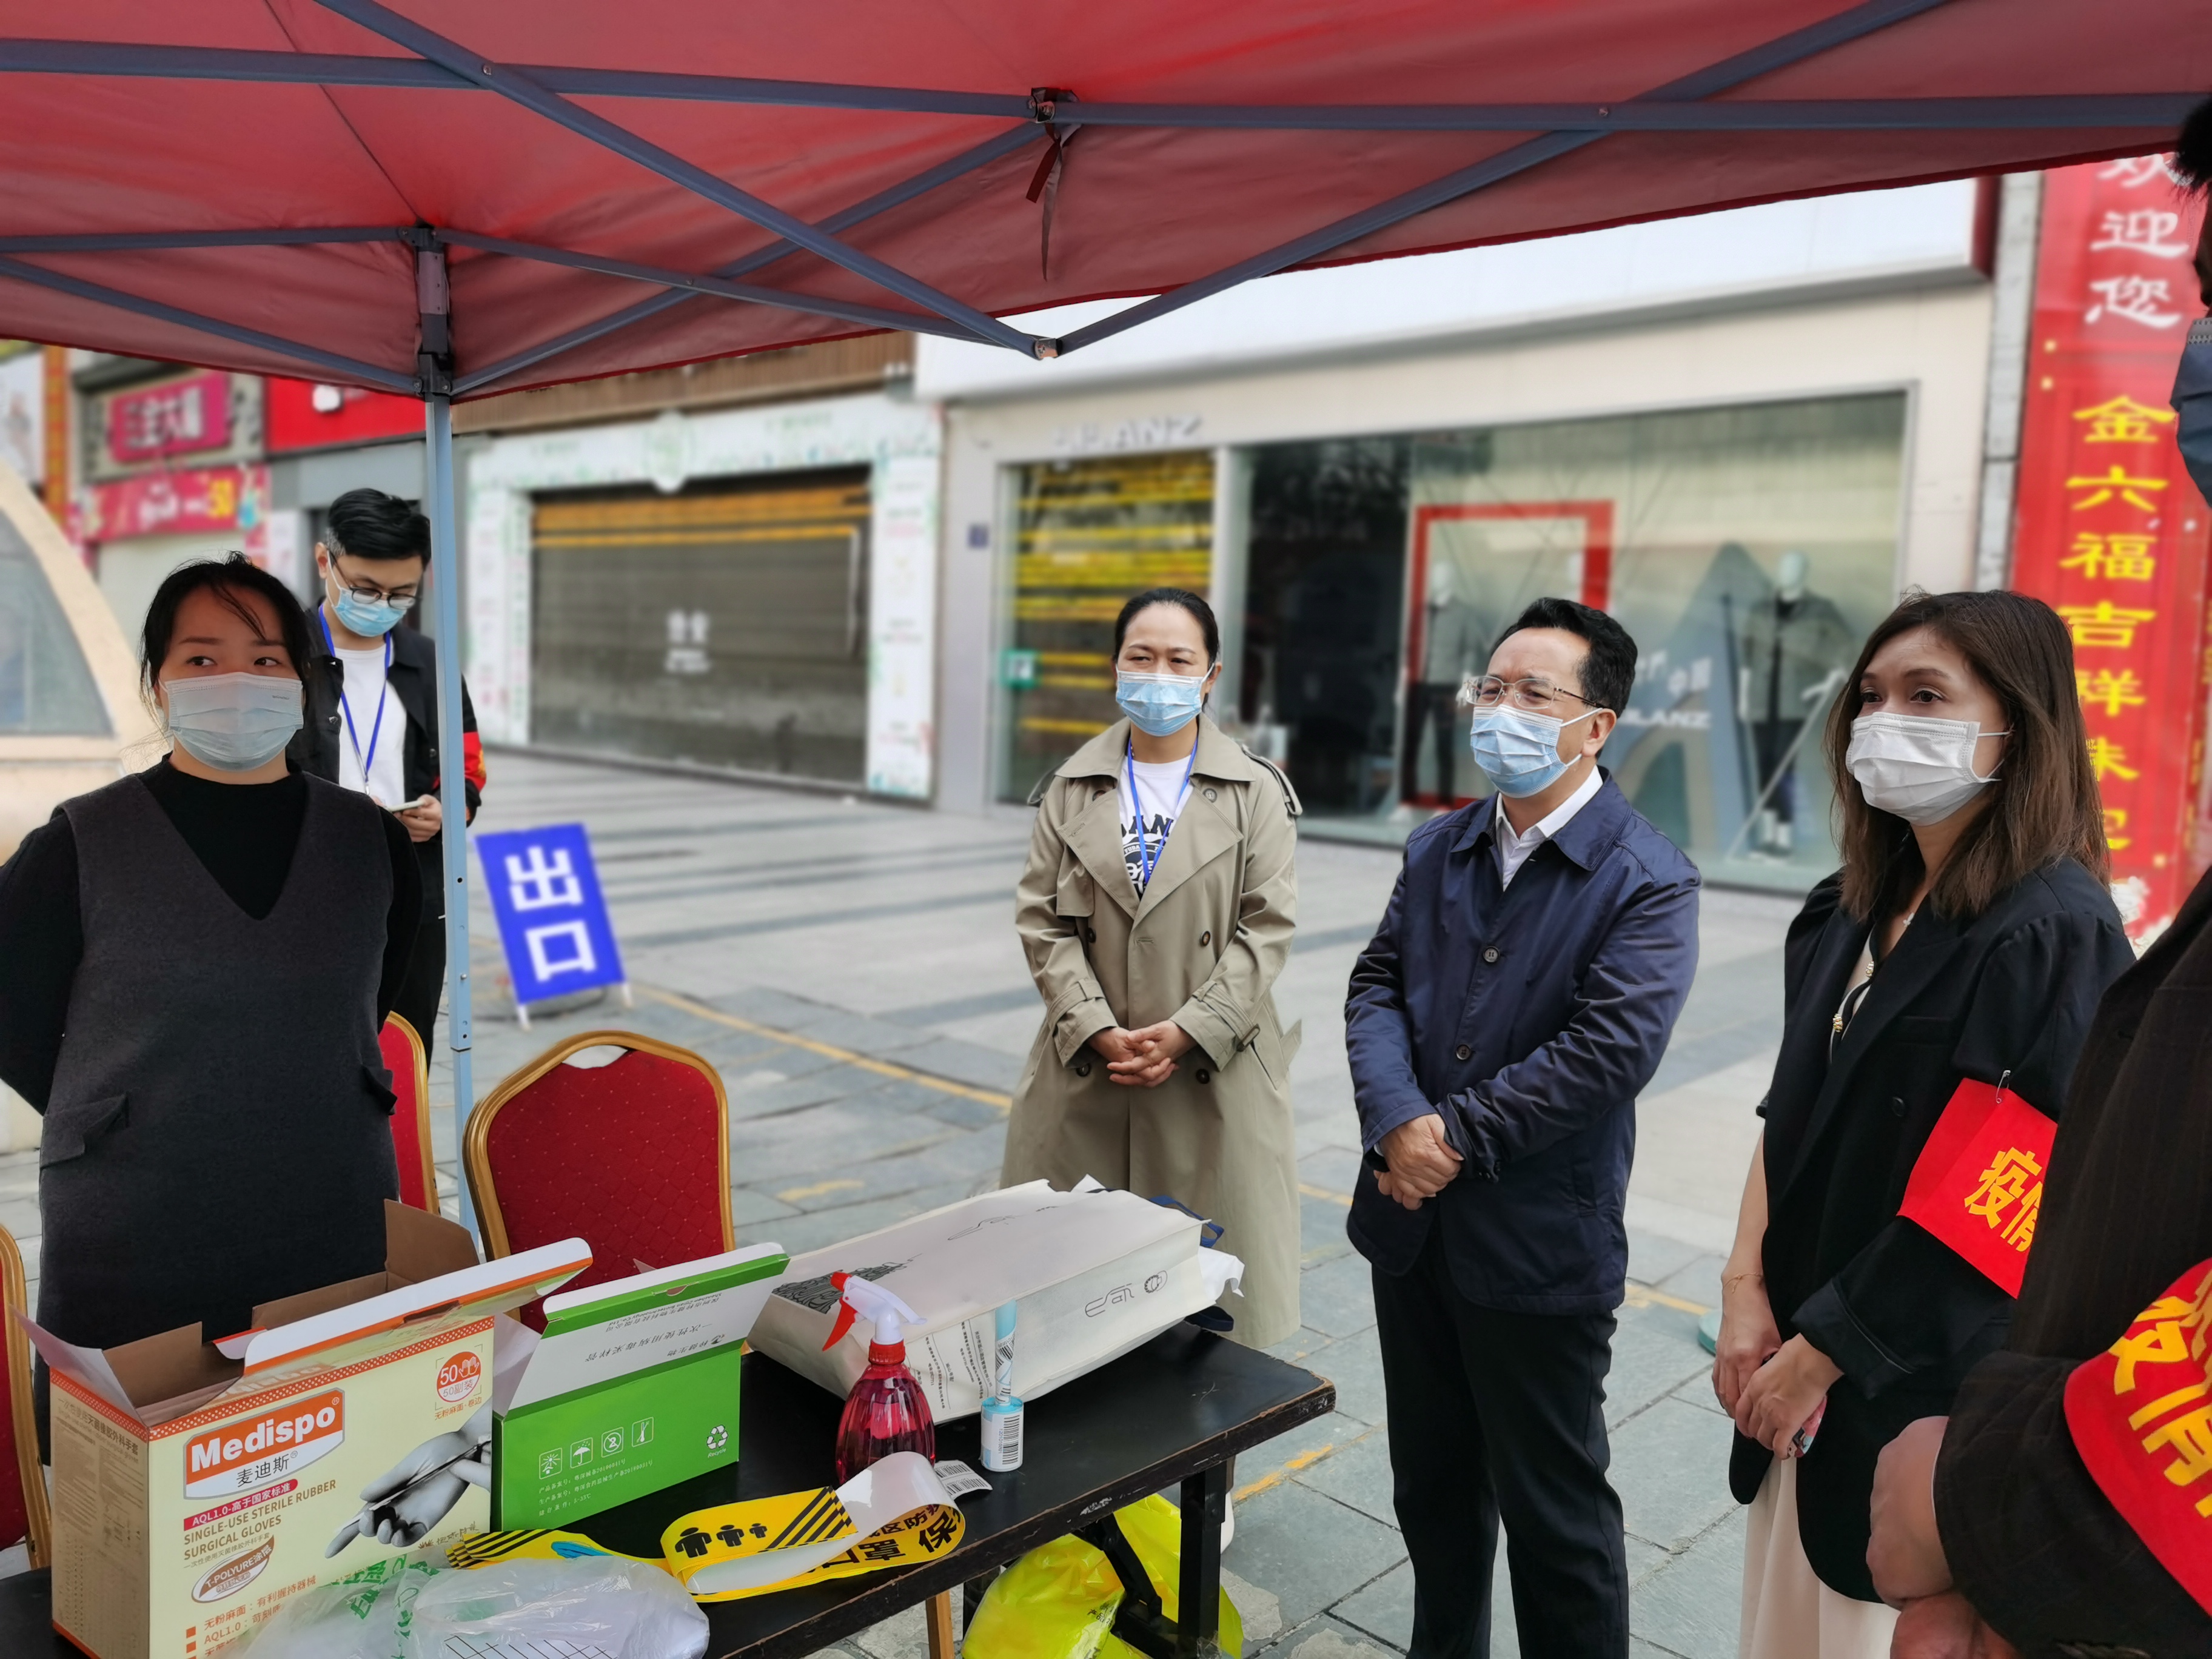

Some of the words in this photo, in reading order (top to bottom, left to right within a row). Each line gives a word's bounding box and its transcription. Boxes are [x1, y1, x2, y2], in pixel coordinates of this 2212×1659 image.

[504, 845, 597, 982] 出口
[585, 1323, 712, 1362] 一次性使用病毒采样管
[440, 1364, 458, 1386] 50
[443, 1379, 474, 1398] 50副装
[192, 1406, 336, 1473] Medispo
[236, 1453, 290, 1488] 麦迪斯
[184, 1512, 249, 1546] SINGLE-USE
[251, 1495, 293, 1520] STERILE
[295, 1479, 337, 1504] RUBBER
[192, 1483, 291, 1527] AQL1.0-高于国家标准
[184, 1533, 239, 1561] SURGICAL
[241, 1515, 282, 1538] GLOVES
